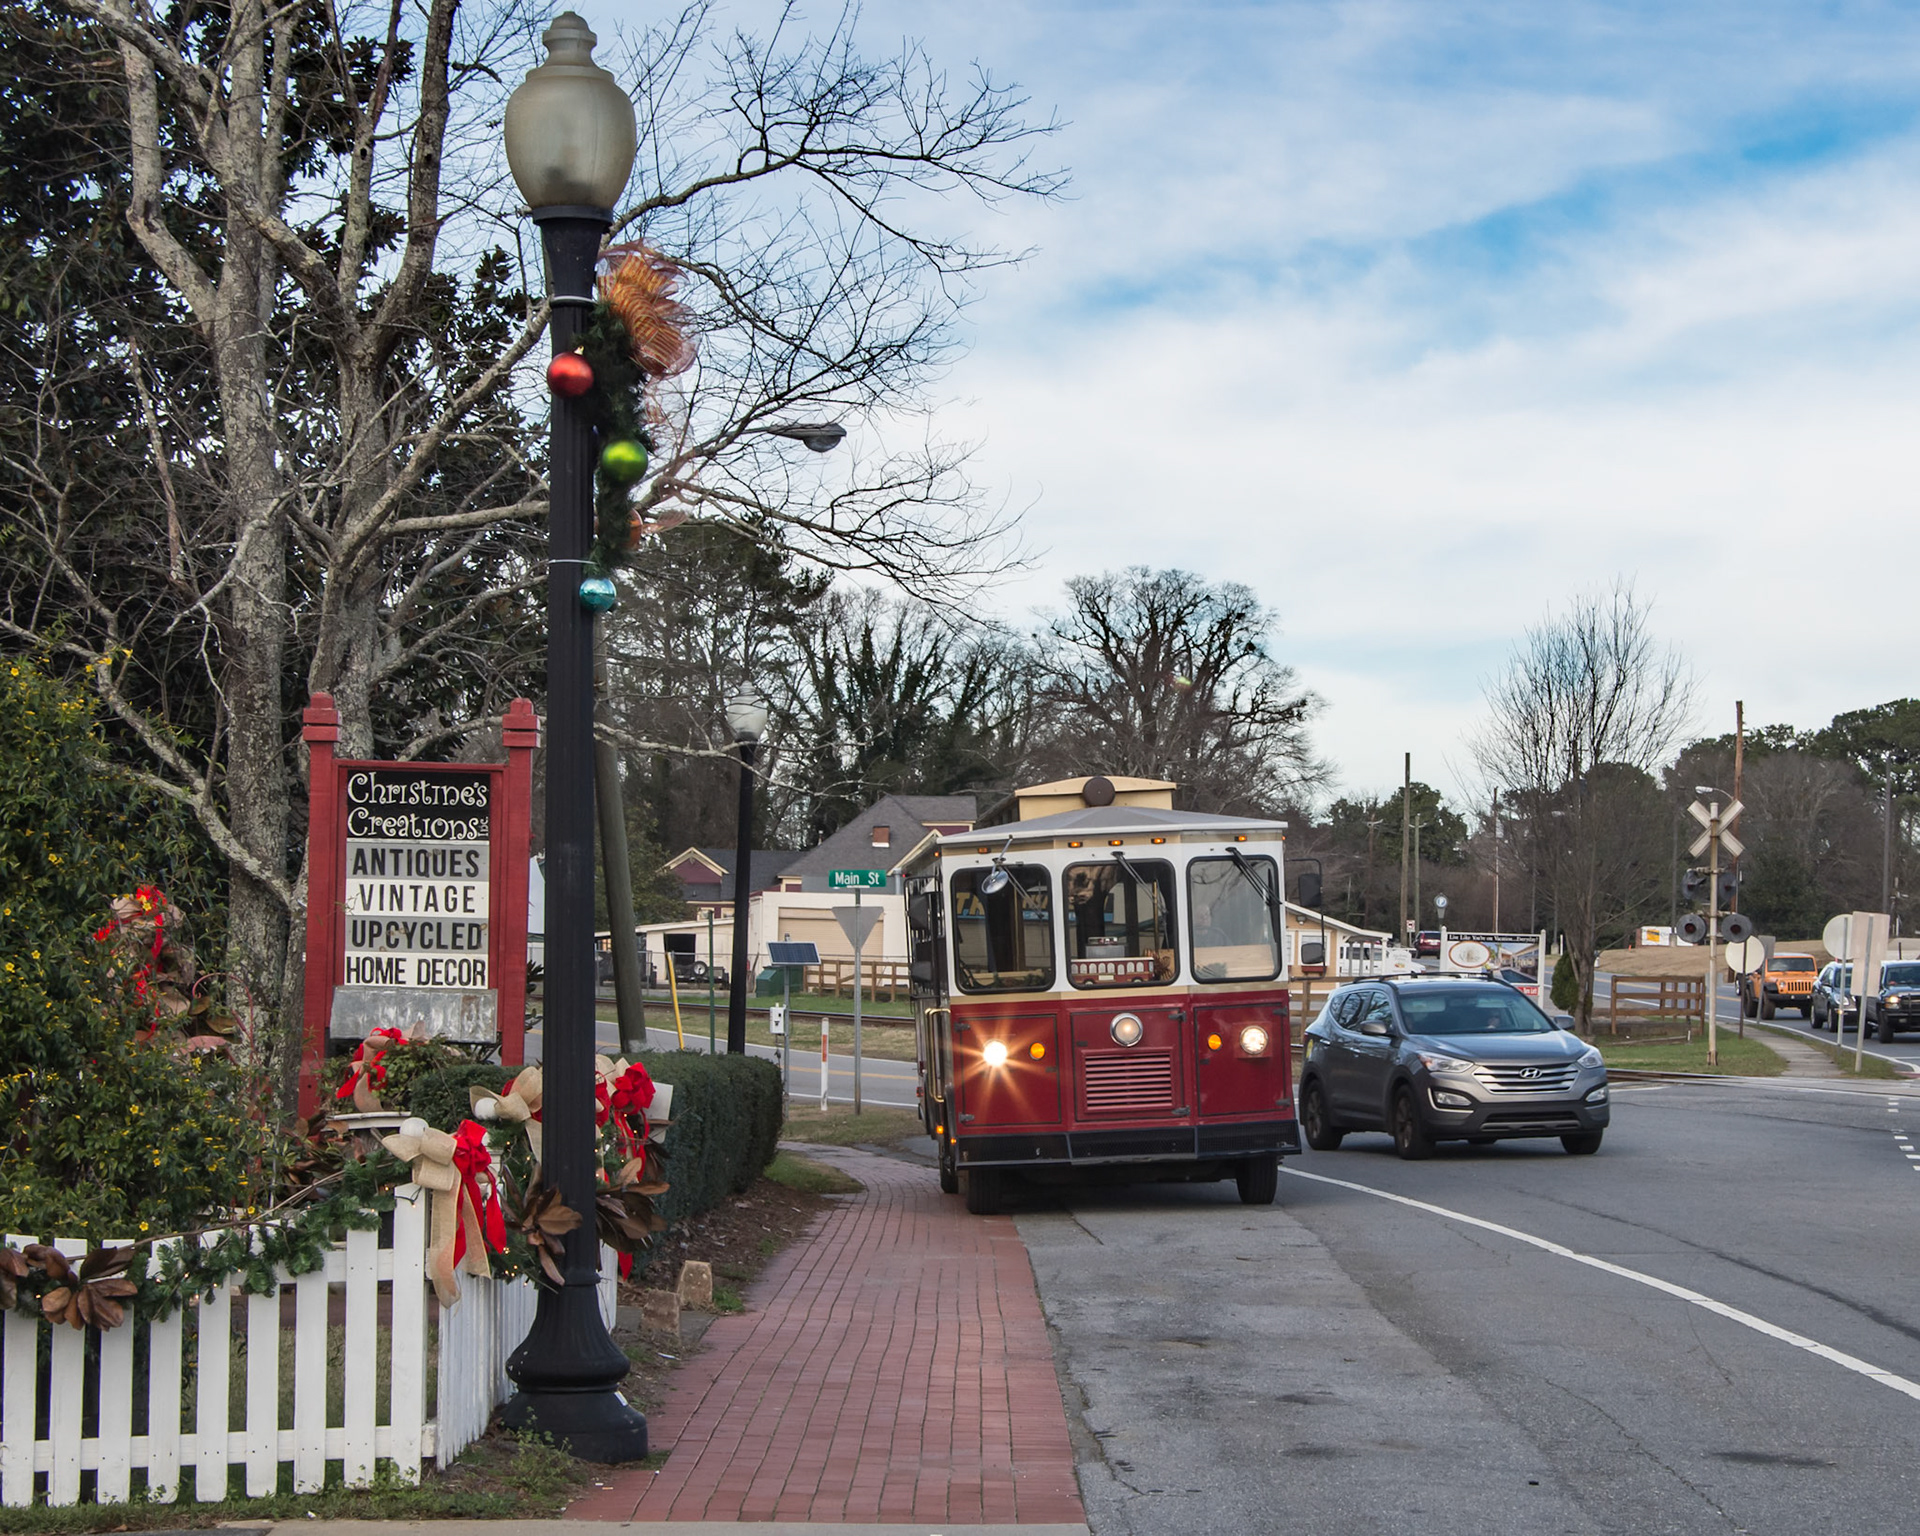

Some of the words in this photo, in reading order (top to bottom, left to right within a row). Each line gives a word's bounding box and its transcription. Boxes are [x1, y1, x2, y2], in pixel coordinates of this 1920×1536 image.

[347, 771, 488, 808] Christine's
[347, 806, 479, 840] Creations
[352, 848, 480, 878] ANTIQUES
[834, 871, 860, 885] Main
[867, 871, 880, 885] St
[359, 883, 476, 913] VINTAGE
[351, 919, 482, 951] UPCYCLED
[346, 956, 407, 985] HOME
[417, 958, 486, 986] DECOR
